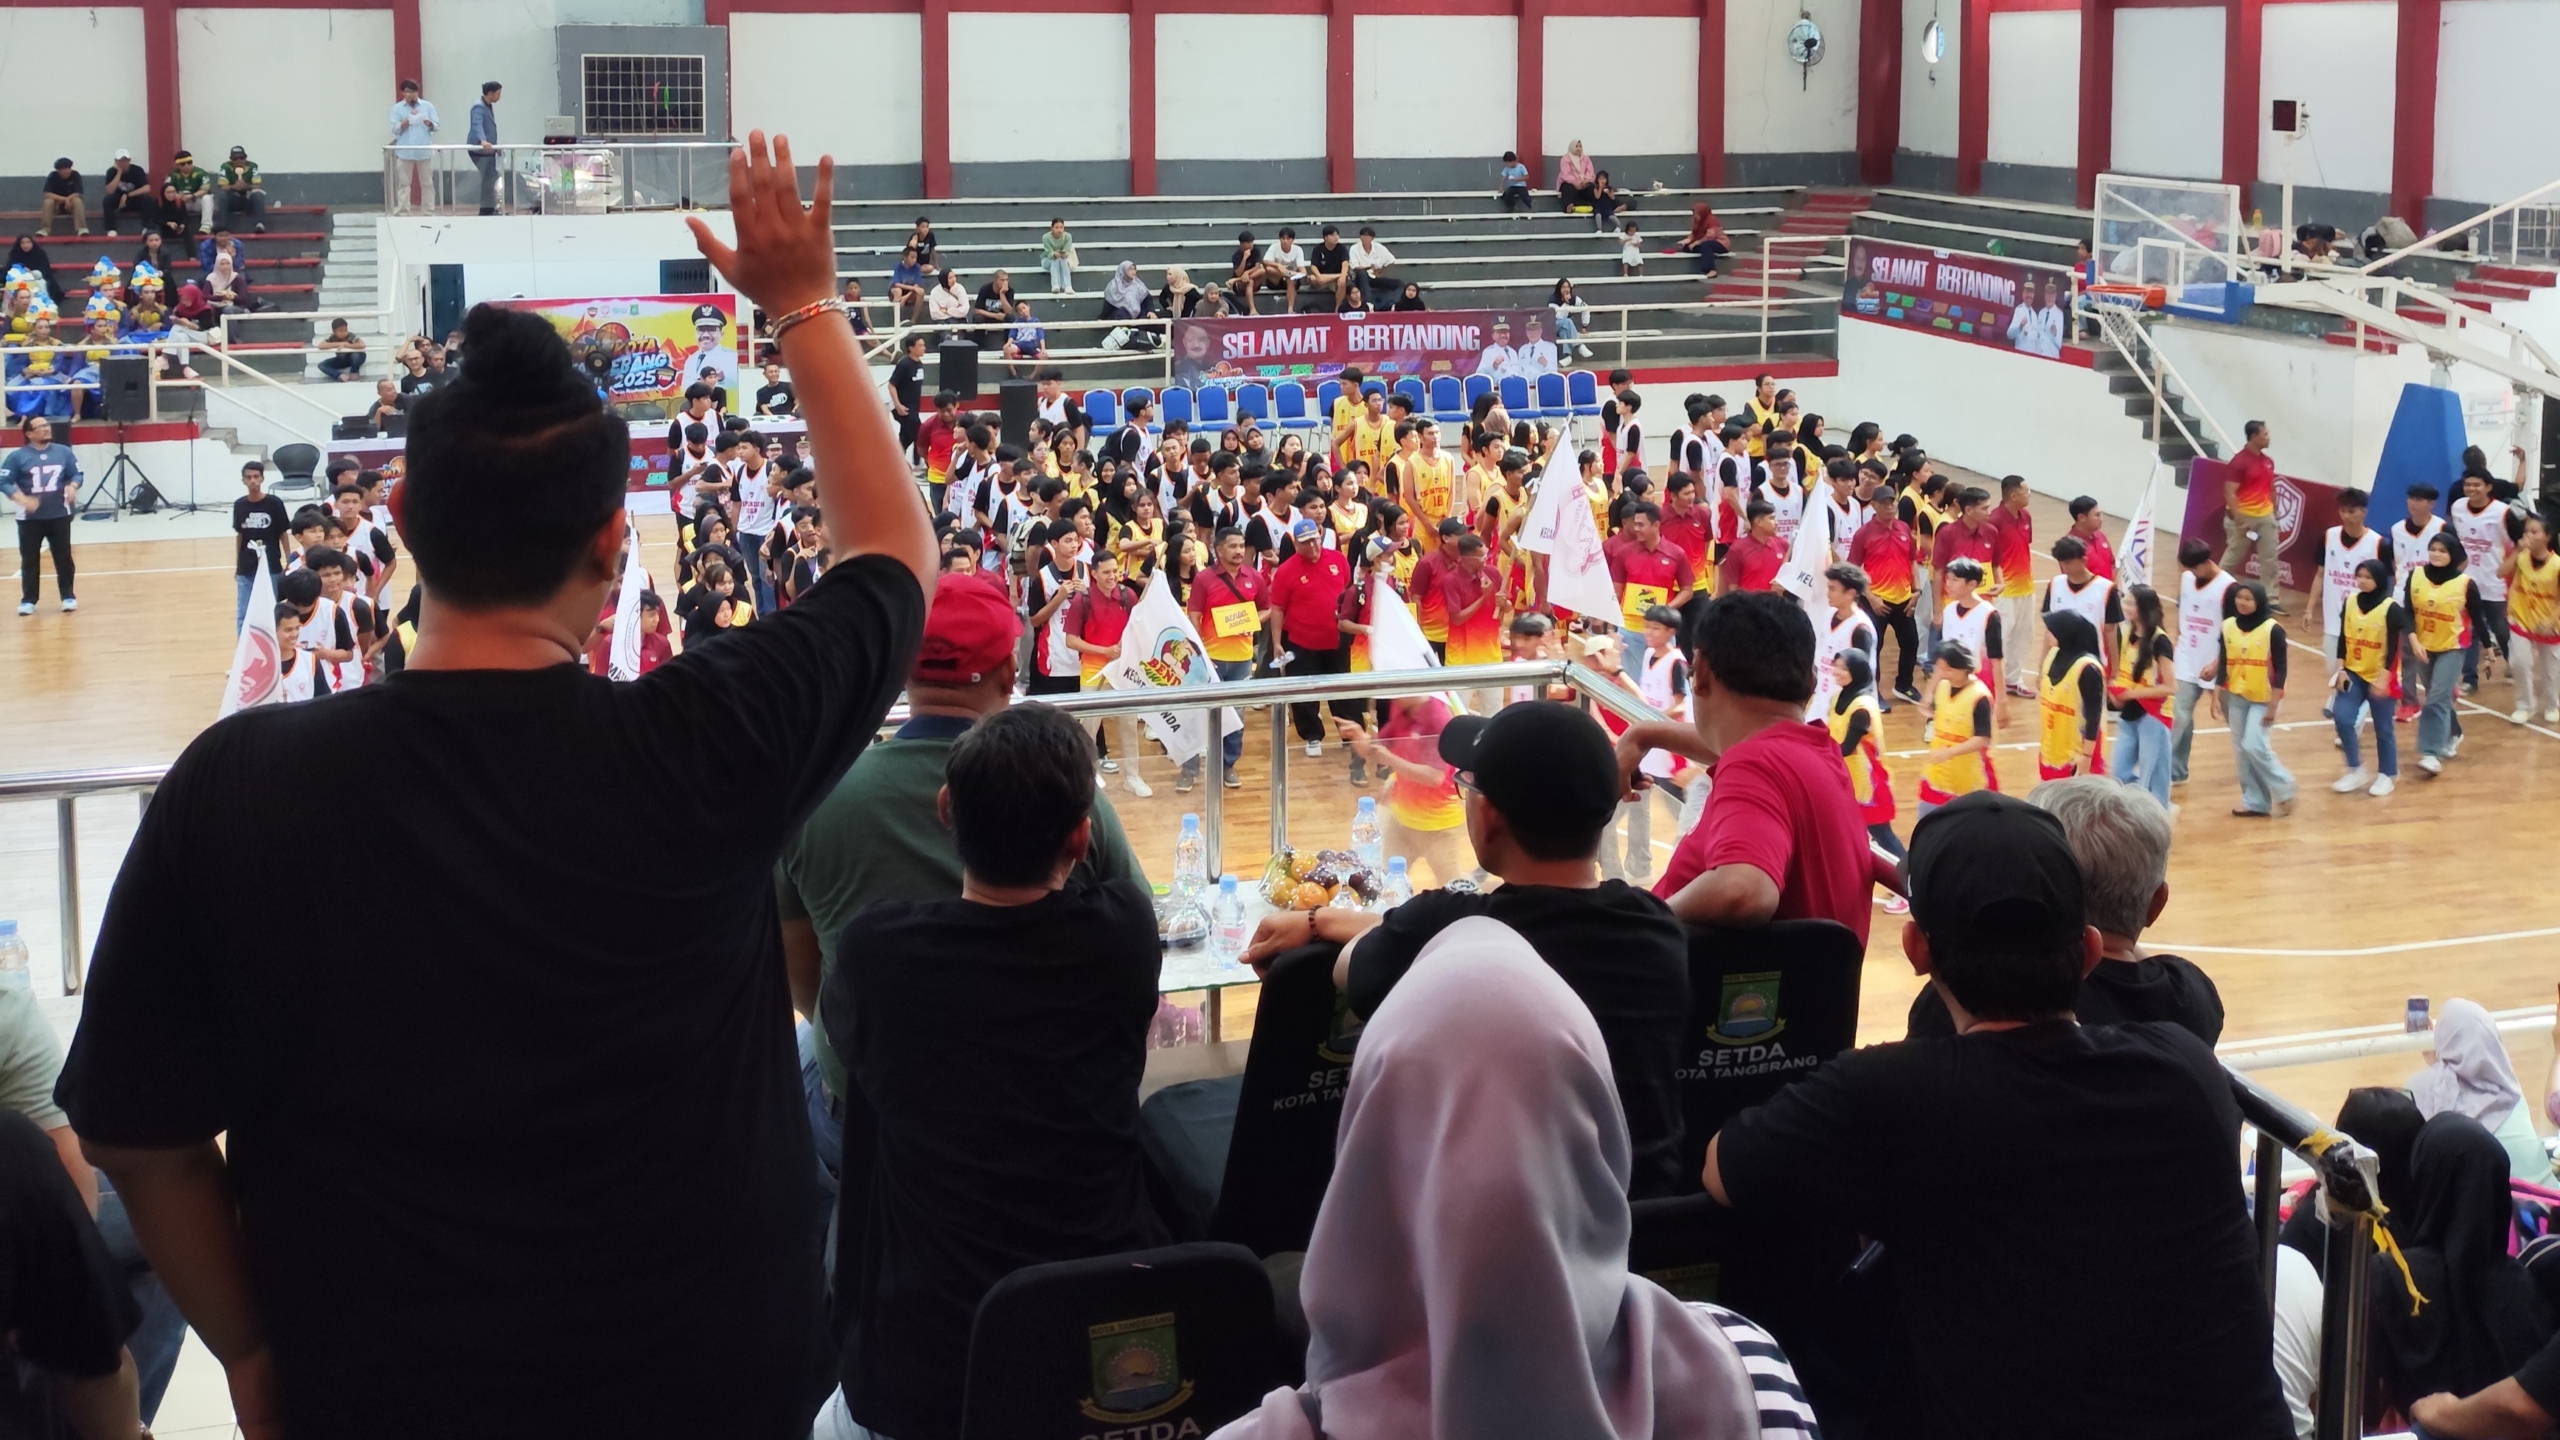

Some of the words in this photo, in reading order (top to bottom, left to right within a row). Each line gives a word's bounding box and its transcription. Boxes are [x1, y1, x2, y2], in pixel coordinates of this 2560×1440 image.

[1871, 257, 1929, 287] SELAMAT
[1936, 264, 2016, 307] BERTANDING
[1222, 326, 1330, 360] SELAMAT
[1349, 324, 1480, 351] BERTANDING
[613, 370, 656, 389] 2025
[29, 464, 62, 493] 17
[1698, 1042, 1786, 1067] SETDA
[1713, 1055, 1818, 1080] TANGERANG
[1273, 1092, 1317, 1111] KOTA
